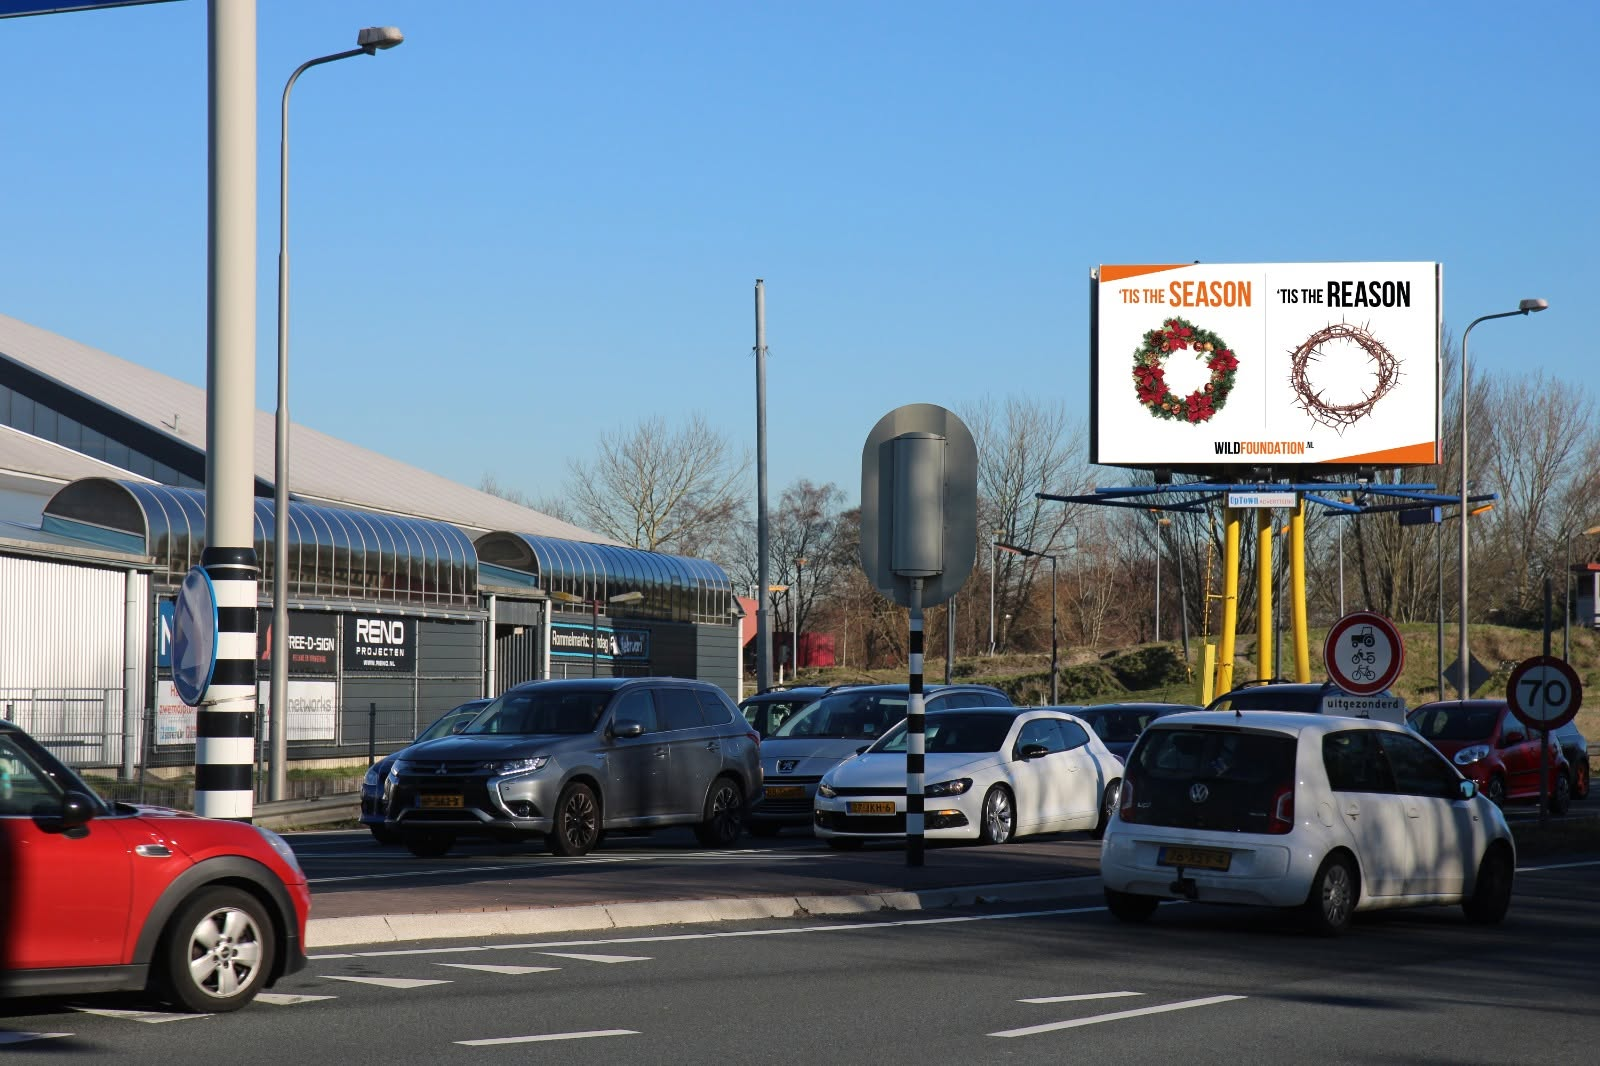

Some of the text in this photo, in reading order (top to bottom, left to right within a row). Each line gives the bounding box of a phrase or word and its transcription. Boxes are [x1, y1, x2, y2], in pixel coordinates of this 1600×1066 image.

[1143, 288, 1166, 304] THE
[1169, 280, 1252, 308] SEASON
[1300, 288, 1324, 304] THE
[1327, 280, 1411, 308] REASON
[356, 618, 404, 645] RENO
[355, 646, 405, 657] PROJECTEN
[1327, 699, 1399, 711] uitgezonderd
[1520, 679, 1567, 708] 70
